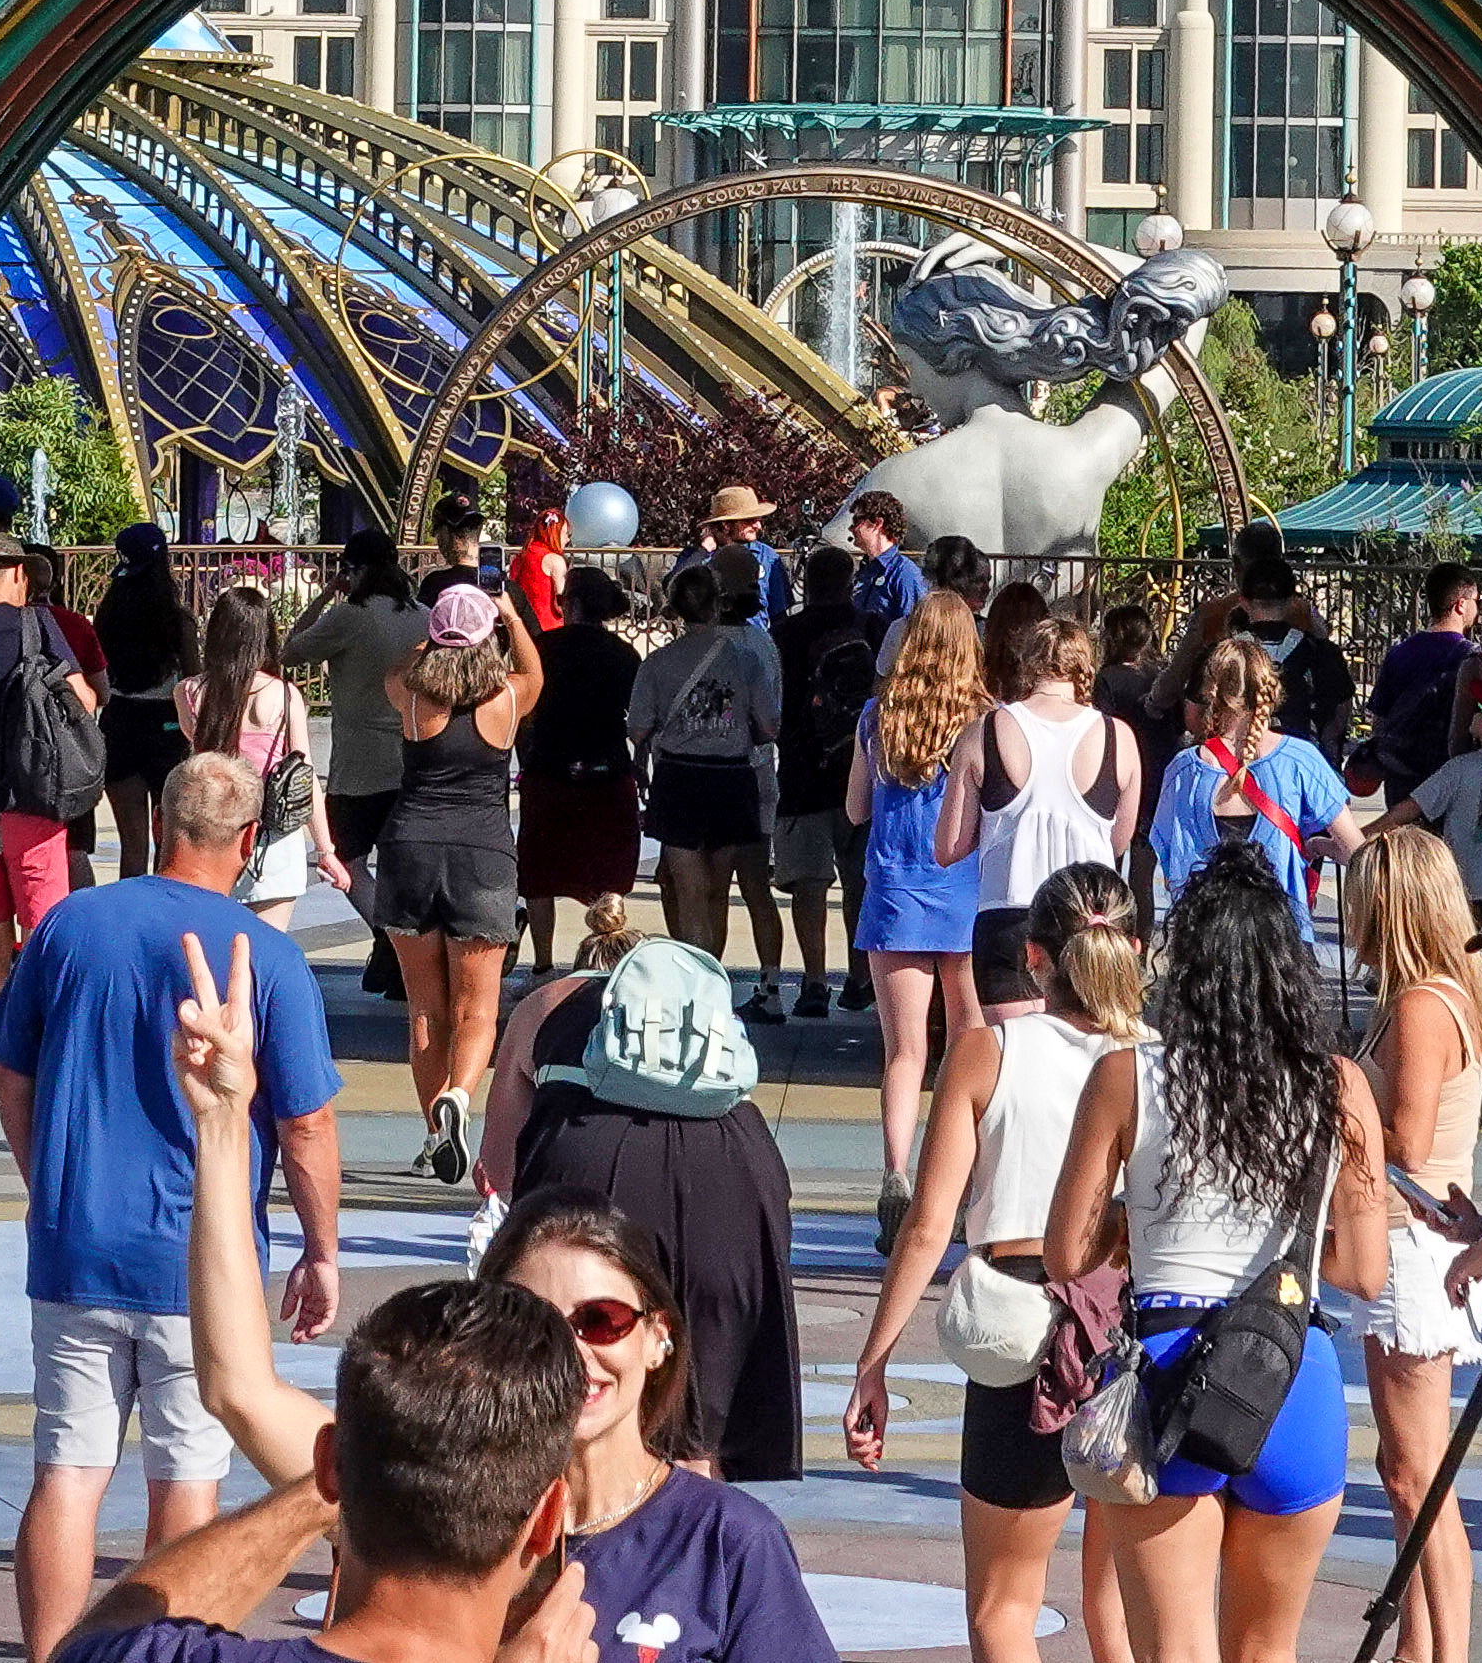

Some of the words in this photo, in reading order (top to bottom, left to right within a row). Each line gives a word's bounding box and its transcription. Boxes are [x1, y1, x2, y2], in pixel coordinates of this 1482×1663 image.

[408, 448, 433, 515] GODDESS
[428, 407, 453, 447] LUNA
[446, 357, 481, 406] DRAWS
[479, 328, 504, 358] THE
[500, 296, 530, 332] VEIL
[532, 257, 580, 303] ACROSS
[582, 235, 611, 261] THE
[617, 208, 674, 240] WORLDS
[679, 197, 700, 216] AS
[706, 182, 767, 206] COLORS
[771, 178, 809, 195] PALE
[830, 177, 861, 193] HER
[869, 179, 941, 206] GLOWING
[946, 193, 981, 216] FACE
[1054, 243, 1083, 270] THE
[1184, 383, 1206, 413] AND
